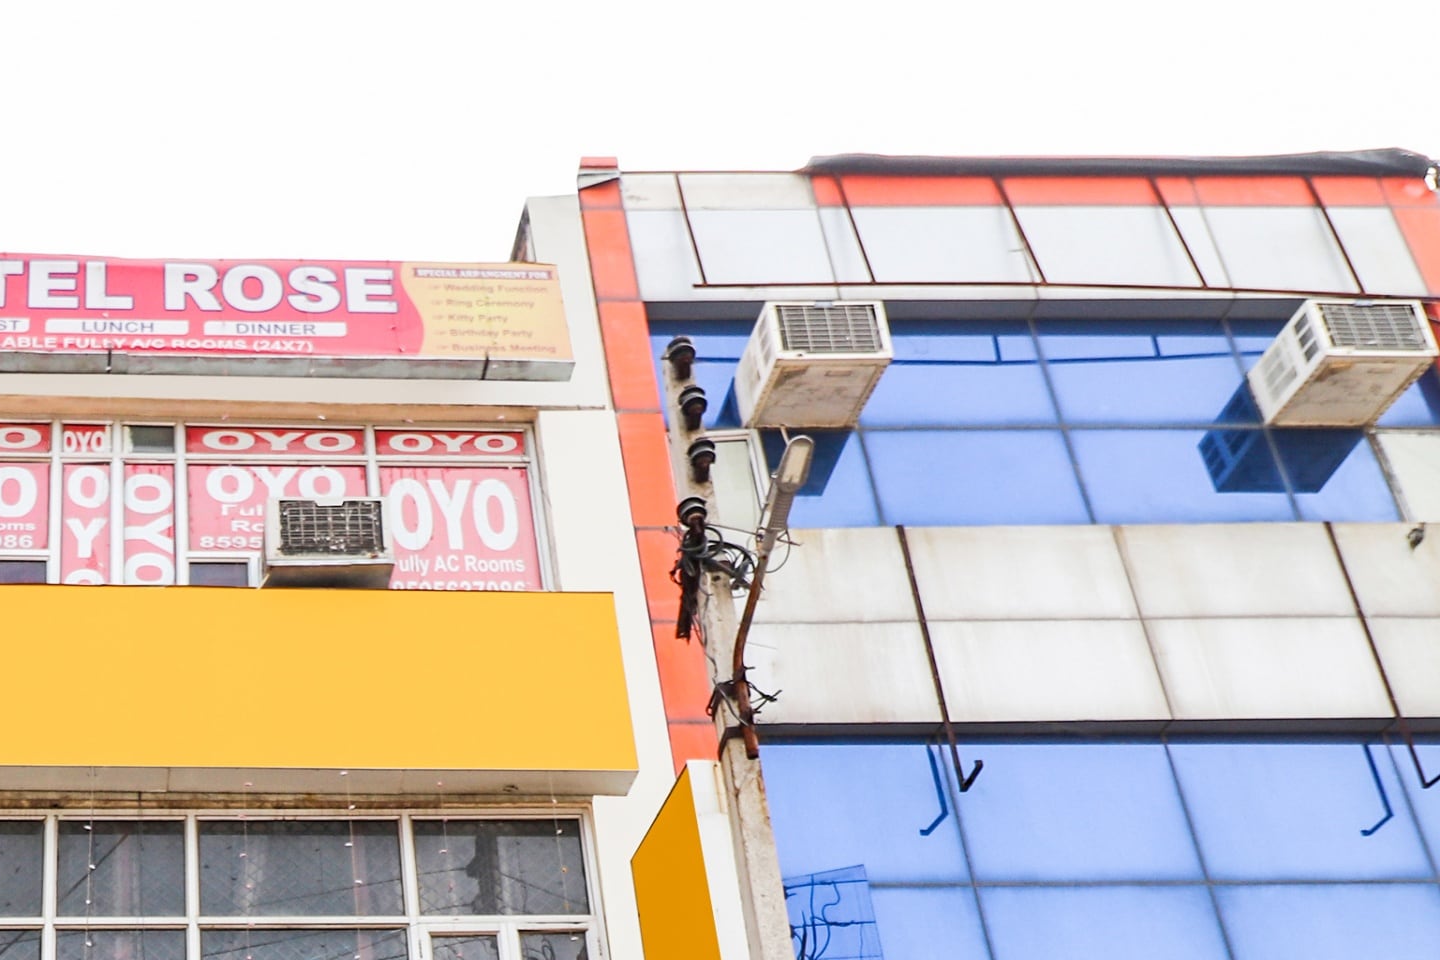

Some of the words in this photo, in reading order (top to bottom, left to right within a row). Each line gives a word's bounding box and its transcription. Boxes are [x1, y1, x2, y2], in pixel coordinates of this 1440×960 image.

[163, 261, 399, 314] ROSE
[444, 284, 494, 293] Wedding
[496, 284, 548, 292] Function
[81, 320, 155, 333] LUNCH
[235, 322, 317, 335] DINNER
[478, 314, 508, 323] Party
[449, 329, 499, 338] Birthday
[502, 329, 533, 338] Party
[63, 337, 126, 349] FULLY
[130, 337, 168, 349] A/C
[171, 339, 256, 351] ROOMS
[252, 339, 314, 352] (24X7)
[63, 430, 106, 453] OYO
[201, 430, 356, 453] OYO
[388, 433, 518, 453] OYO
[205, 465, 347, 504] OYO
[389, 477, 520, 552] OYO
[124, 474, 175, 585] OYO
[394, 554, 430, 577] ully
[434, 555, 460, 572] AC
[464, 555, 526, 572] Rooms
